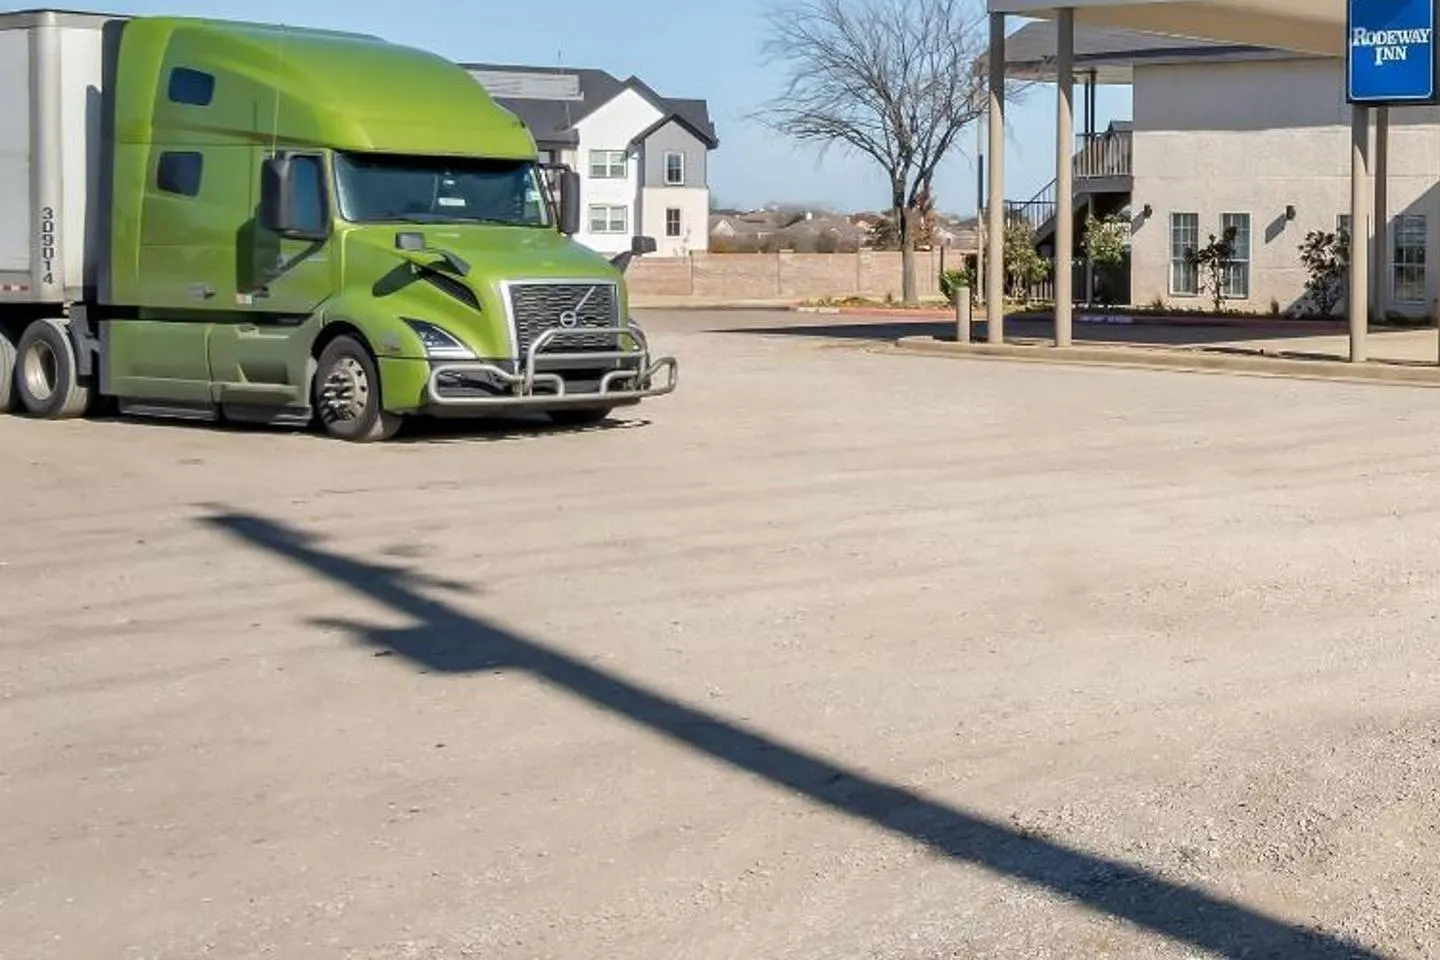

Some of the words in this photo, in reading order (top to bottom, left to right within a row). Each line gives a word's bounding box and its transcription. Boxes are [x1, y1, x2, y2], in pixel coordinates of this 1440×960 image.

[1352, 27, 1431, 46] RODEWAY
[1374, 46, 1407, 66] INN
[42, 206, 54, 285] 309014
